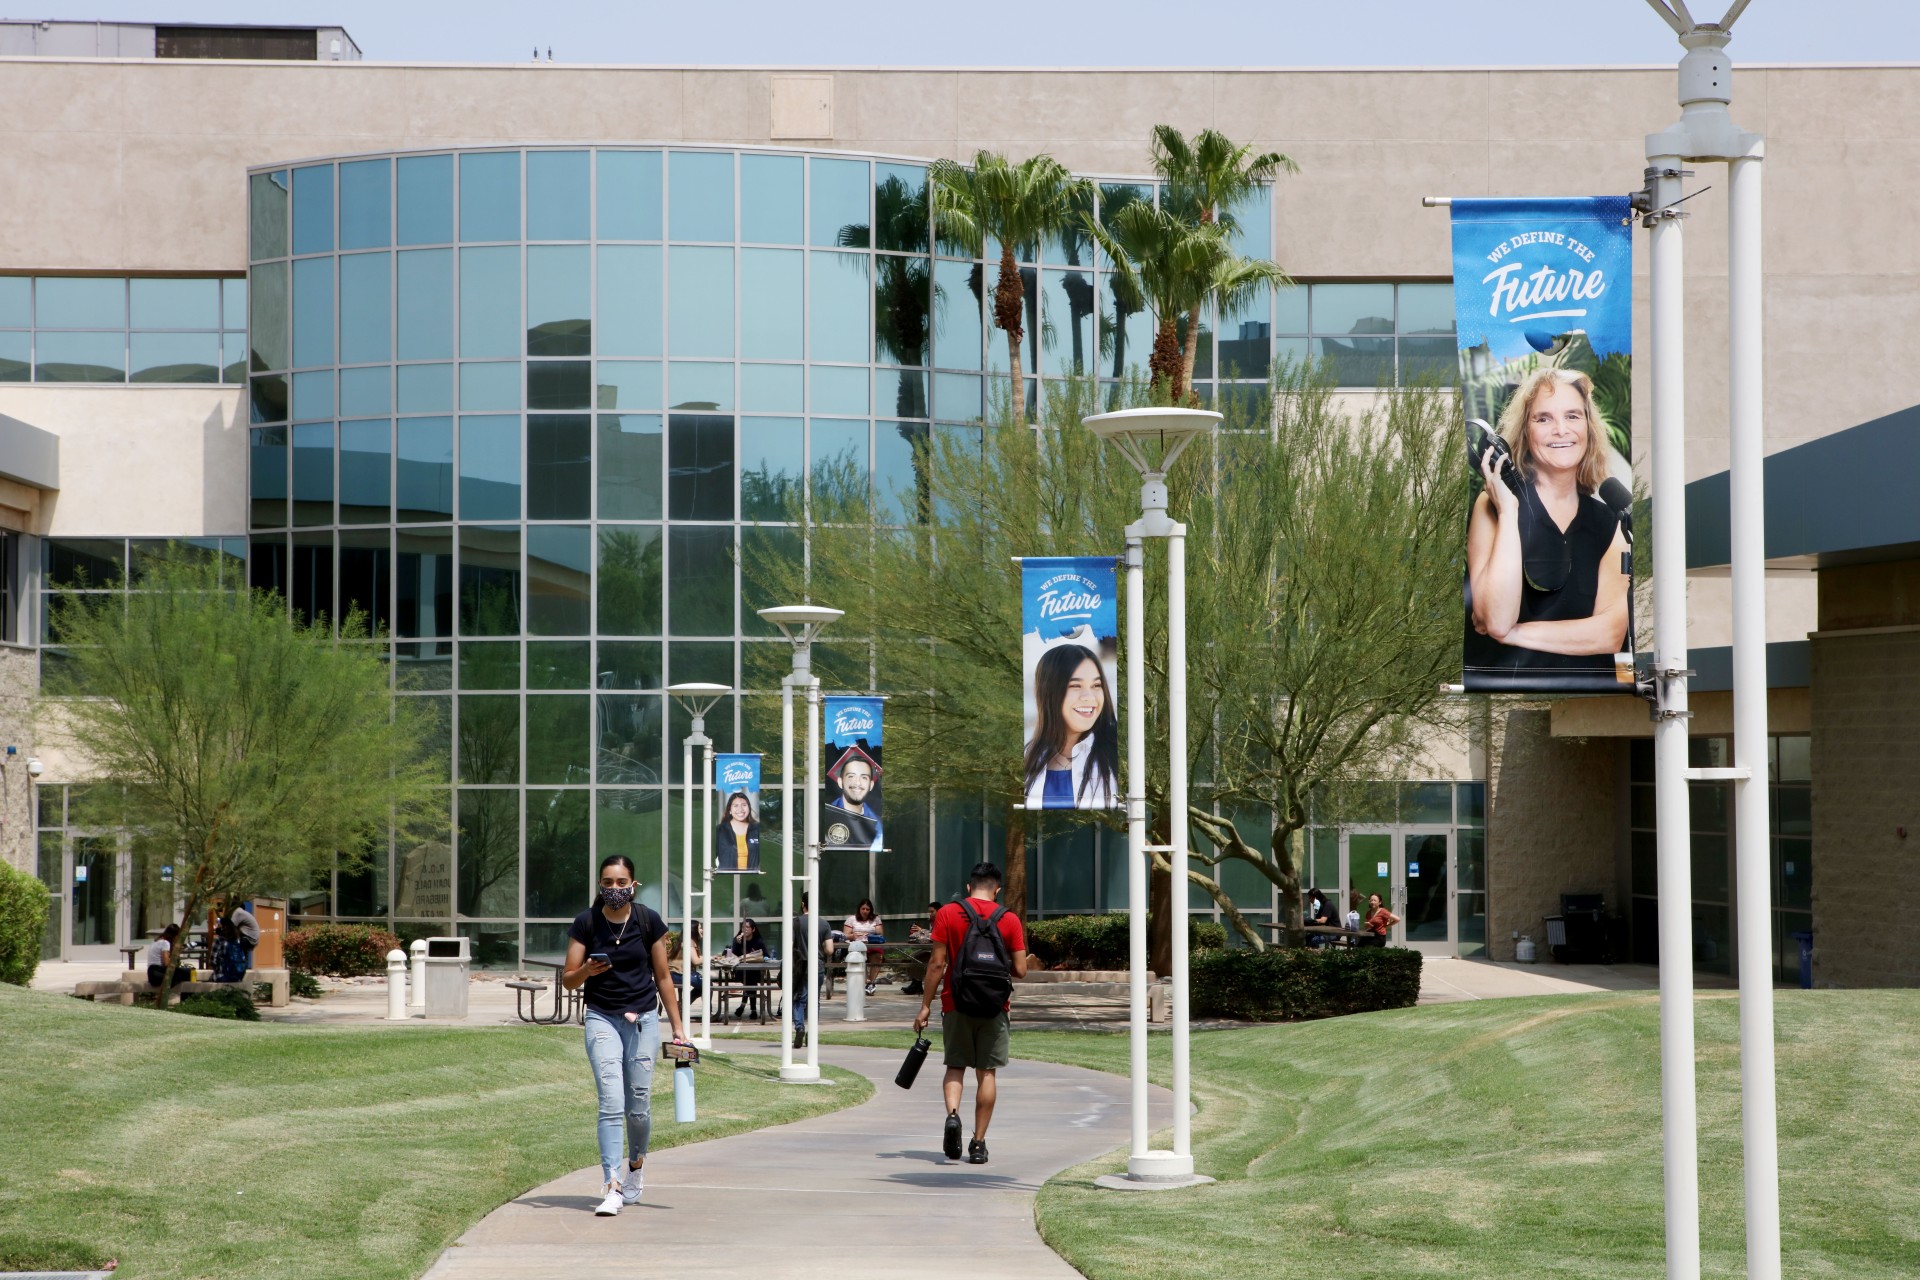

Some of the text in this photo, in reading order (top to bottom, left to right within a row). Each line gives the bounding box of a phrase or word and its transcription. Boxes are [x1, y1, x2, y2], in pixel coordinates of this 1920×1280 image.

[1486, 231, 1596, 264] WE DEFINE THE
[1482, 262, 1606, 318] Future
[1040, 574, 1097, 591] WE DEFINE THE
[1037, 589, 1102, 618] Future
[834, 716, 874, 734] Future
[723, 769, 753, 784] Future
